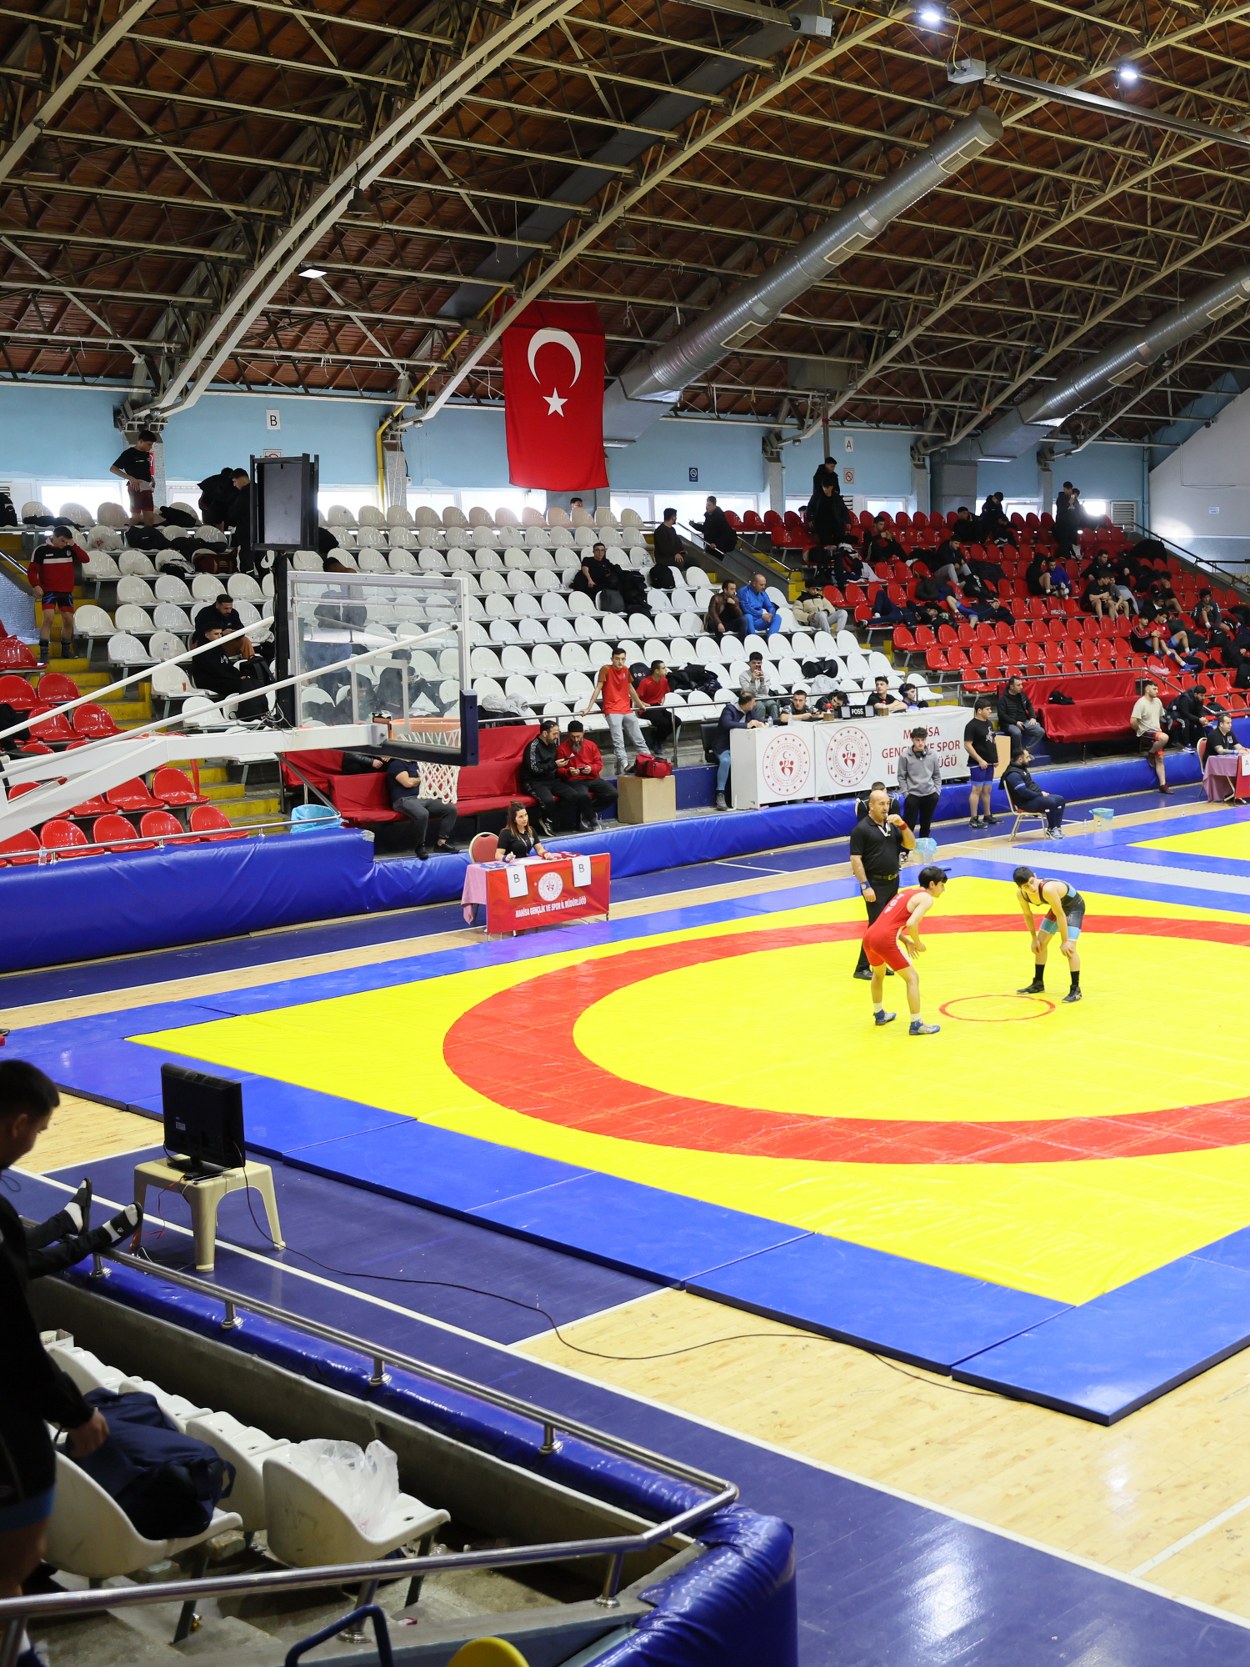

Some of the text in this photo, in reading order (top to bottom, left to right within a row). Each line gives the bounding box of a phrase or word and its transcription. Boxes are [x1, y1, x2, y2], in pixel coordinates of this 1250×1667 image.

[269, 414, 278, 427] B
[847, 440, 852, 449] A
[937, 739, 961, 752] SPOR
[887, 762, 896, 775] İL
[513, 863, 585, 883] B B
